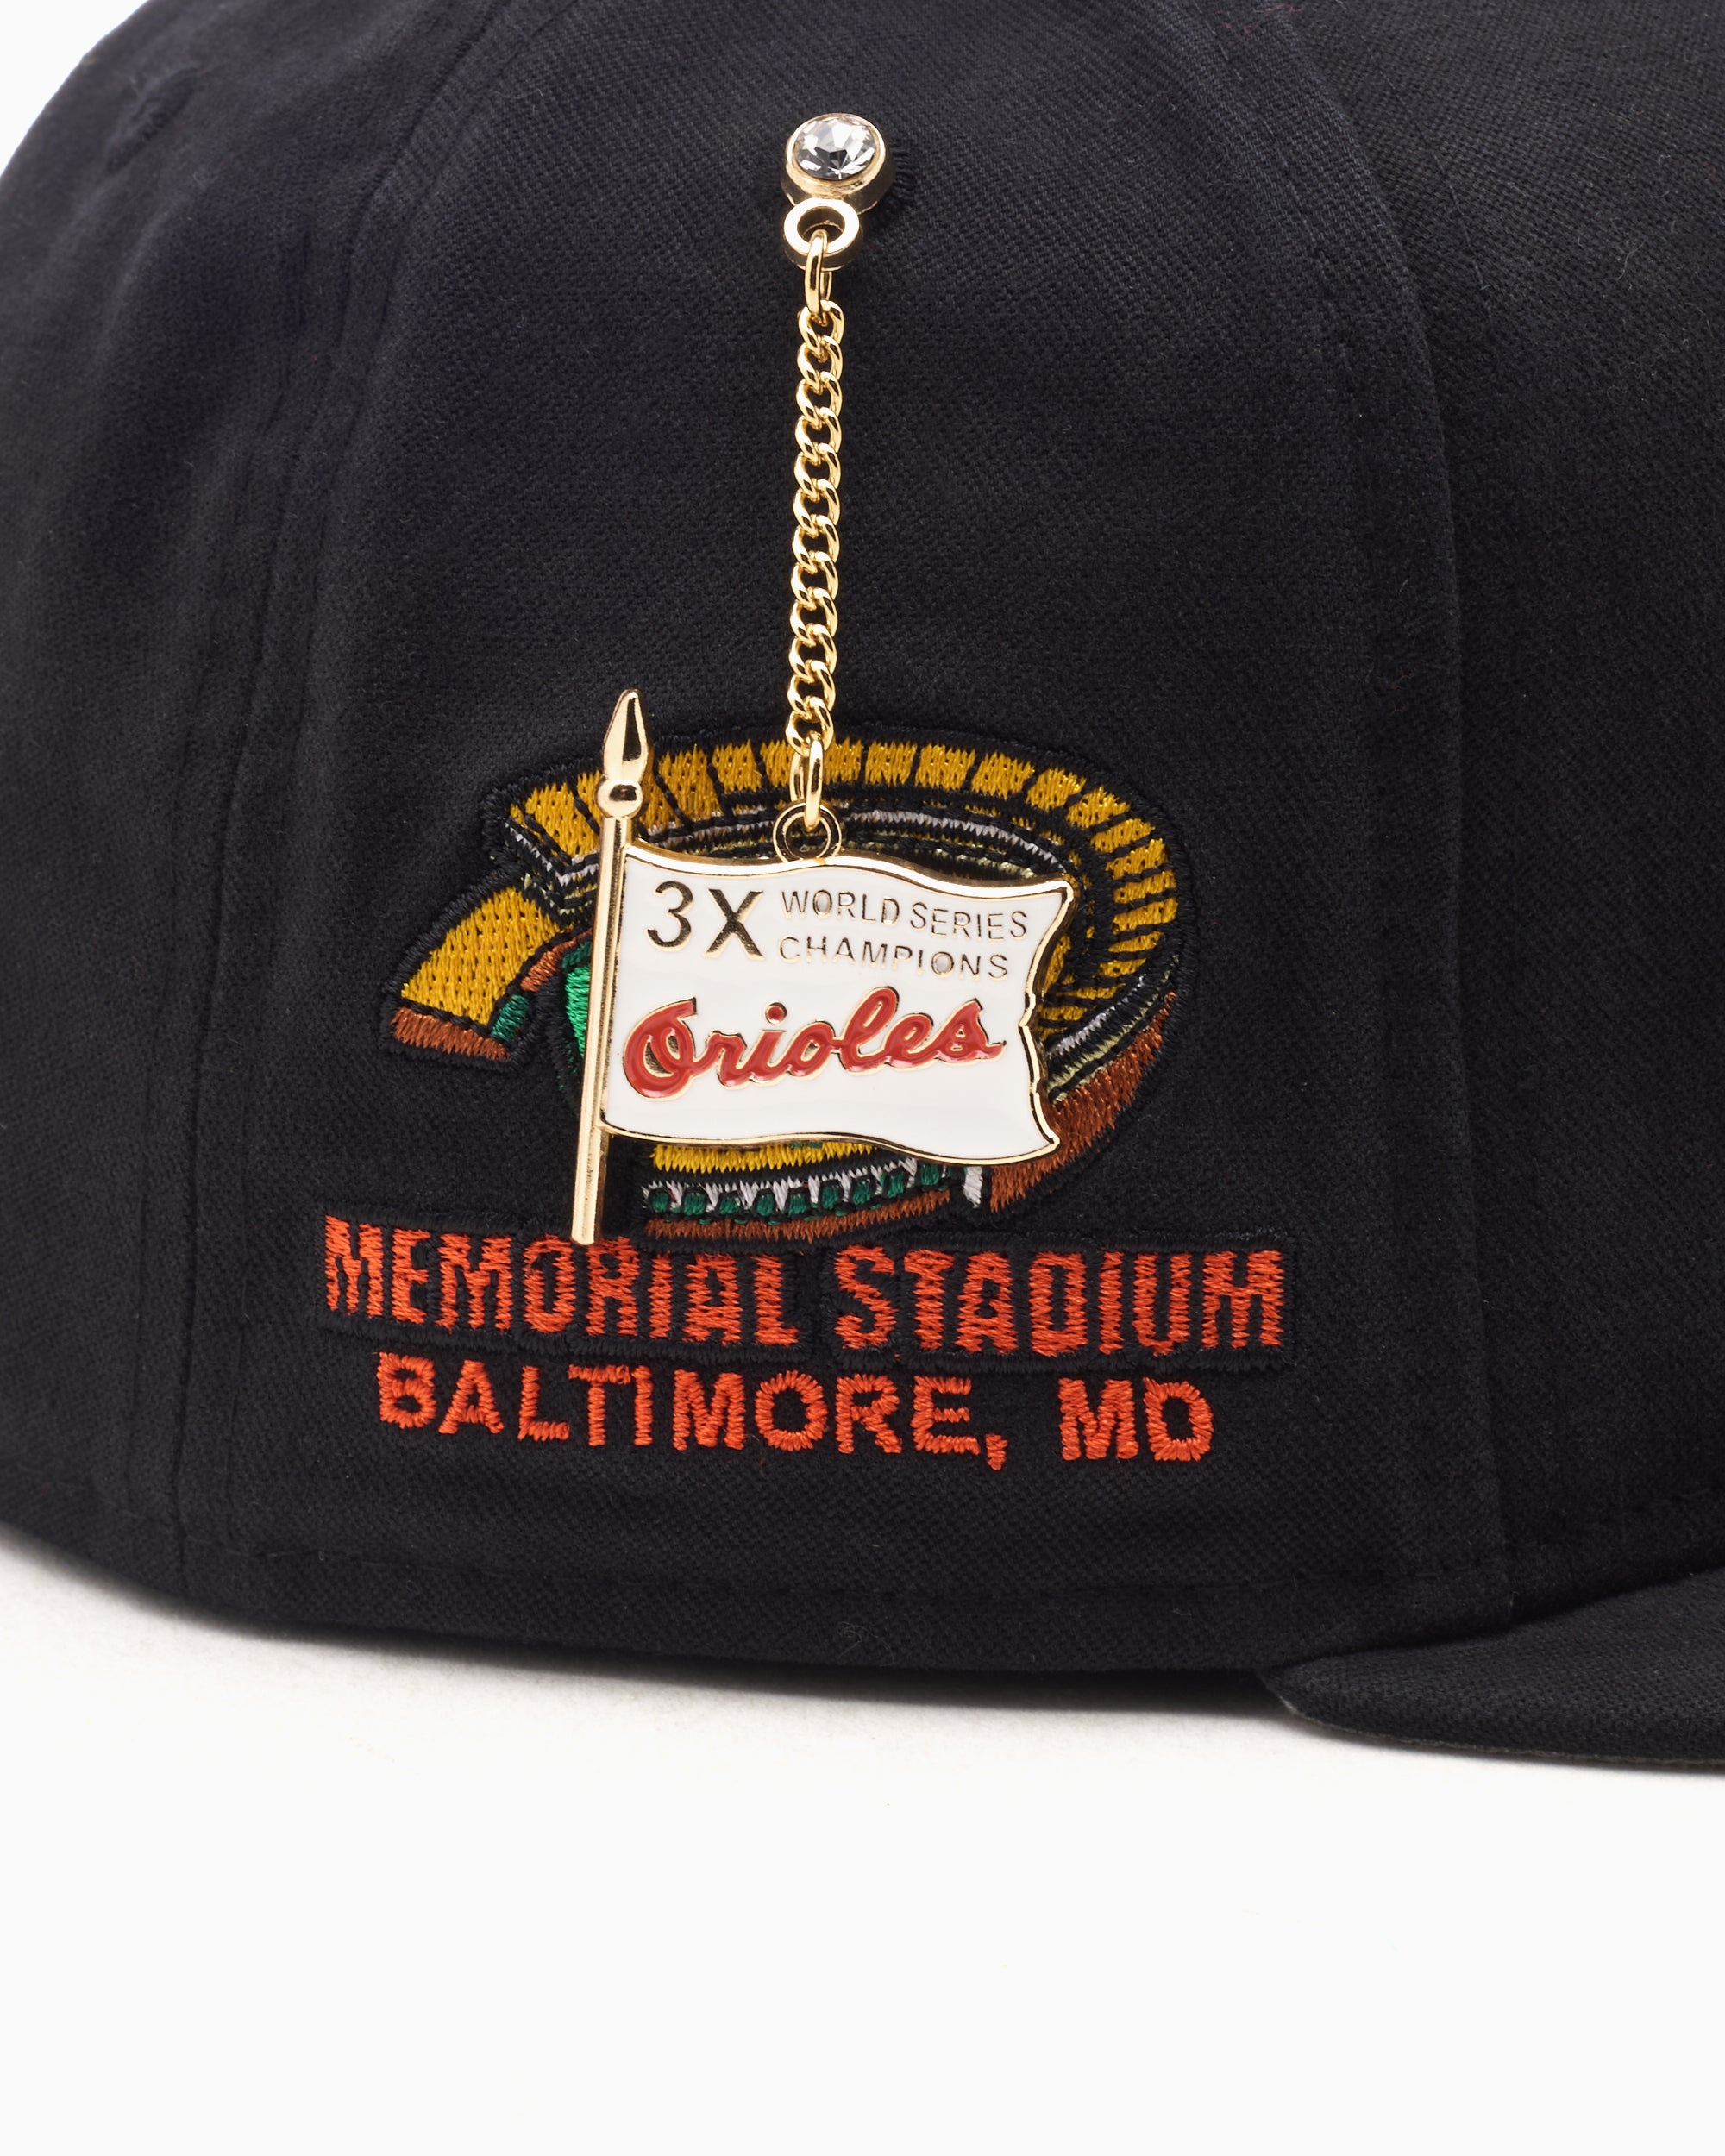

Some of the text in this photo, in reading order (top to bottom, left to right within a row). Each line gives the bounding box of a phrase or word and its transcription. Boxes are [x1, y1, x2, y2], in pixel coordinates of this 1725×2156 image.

[779, 935, 1008, 981] CHAMPIONS
[781, 889, 900, 925] WORLD
[910, 902, 1027, 940] SERIES
[623, 986, 1006, 1100] Orioles
[324, 1215, 1285, 1357] MEMORIAL STADIUM
[377, 1351, 1214, 1471] BALTIMORE, MD
